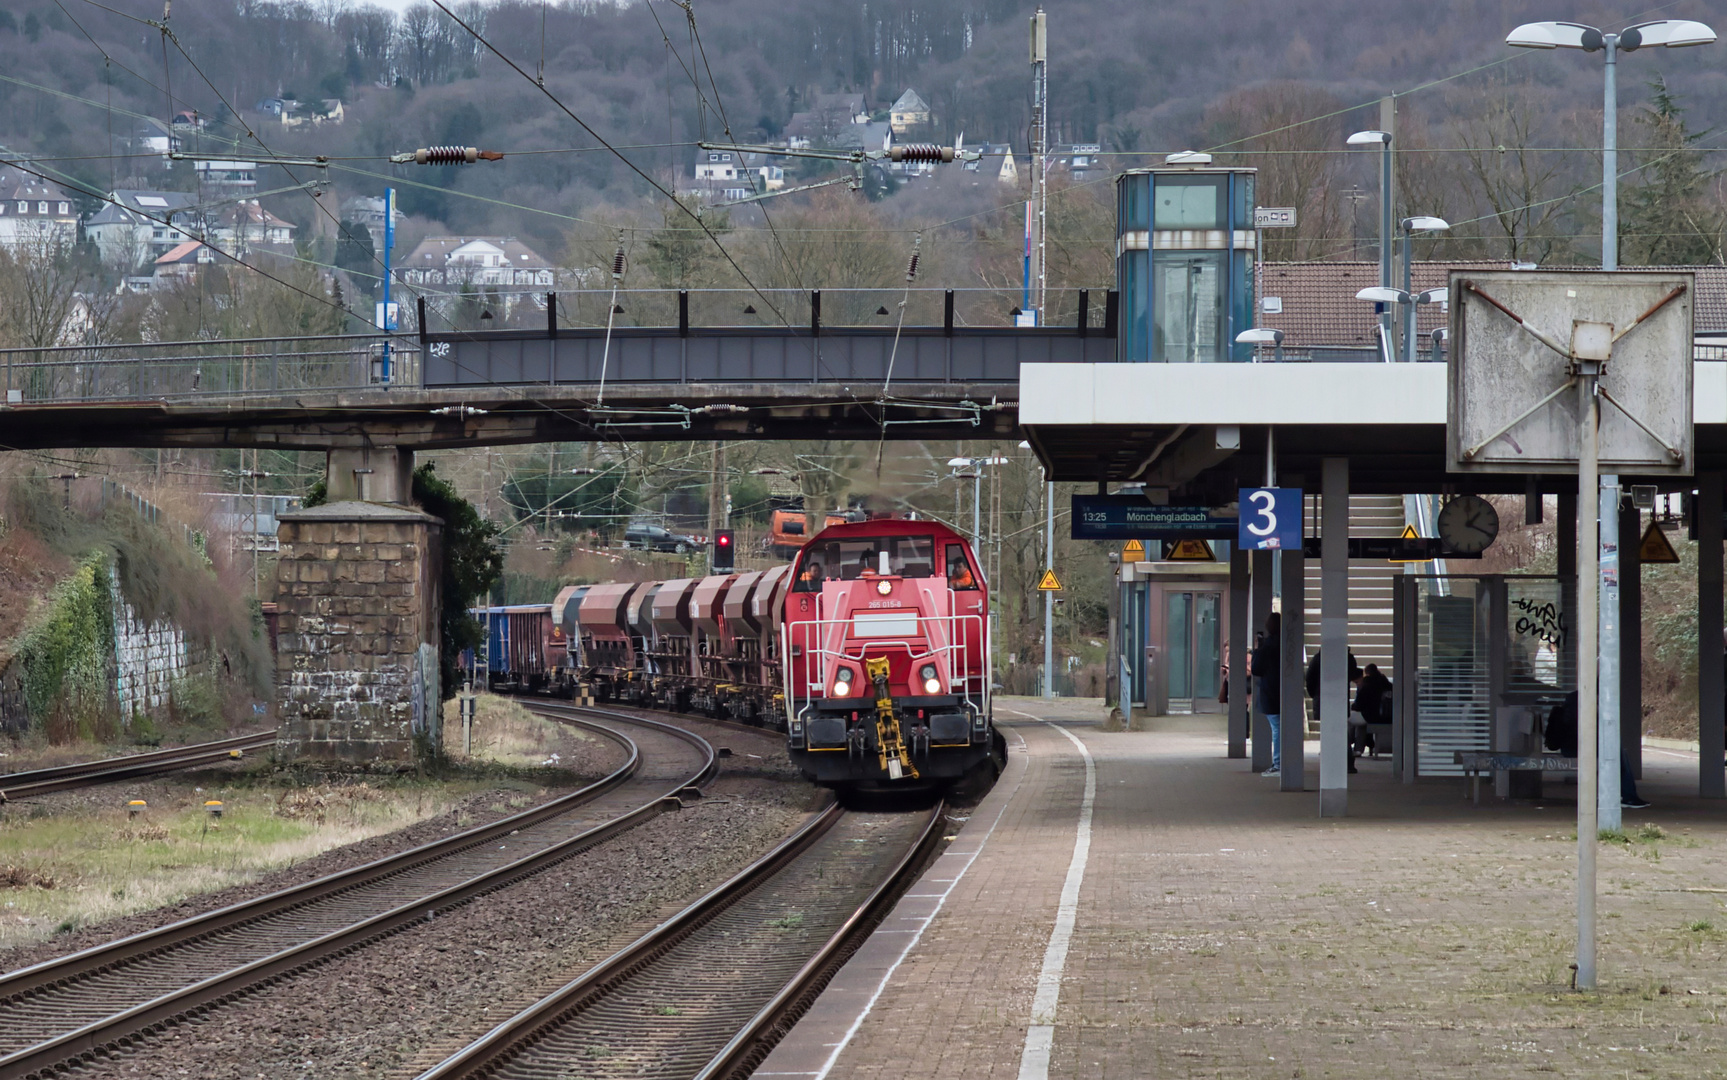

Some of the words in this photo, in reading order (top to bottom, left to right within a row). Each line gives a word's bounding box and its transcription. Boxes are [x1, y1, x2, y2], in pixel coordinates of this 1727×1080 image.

[1082, 512, 1107, 522] 13:25
[1126, 512, 1206, 523] Mönchengladbach
[1247, 490, 1277, 536] 3
